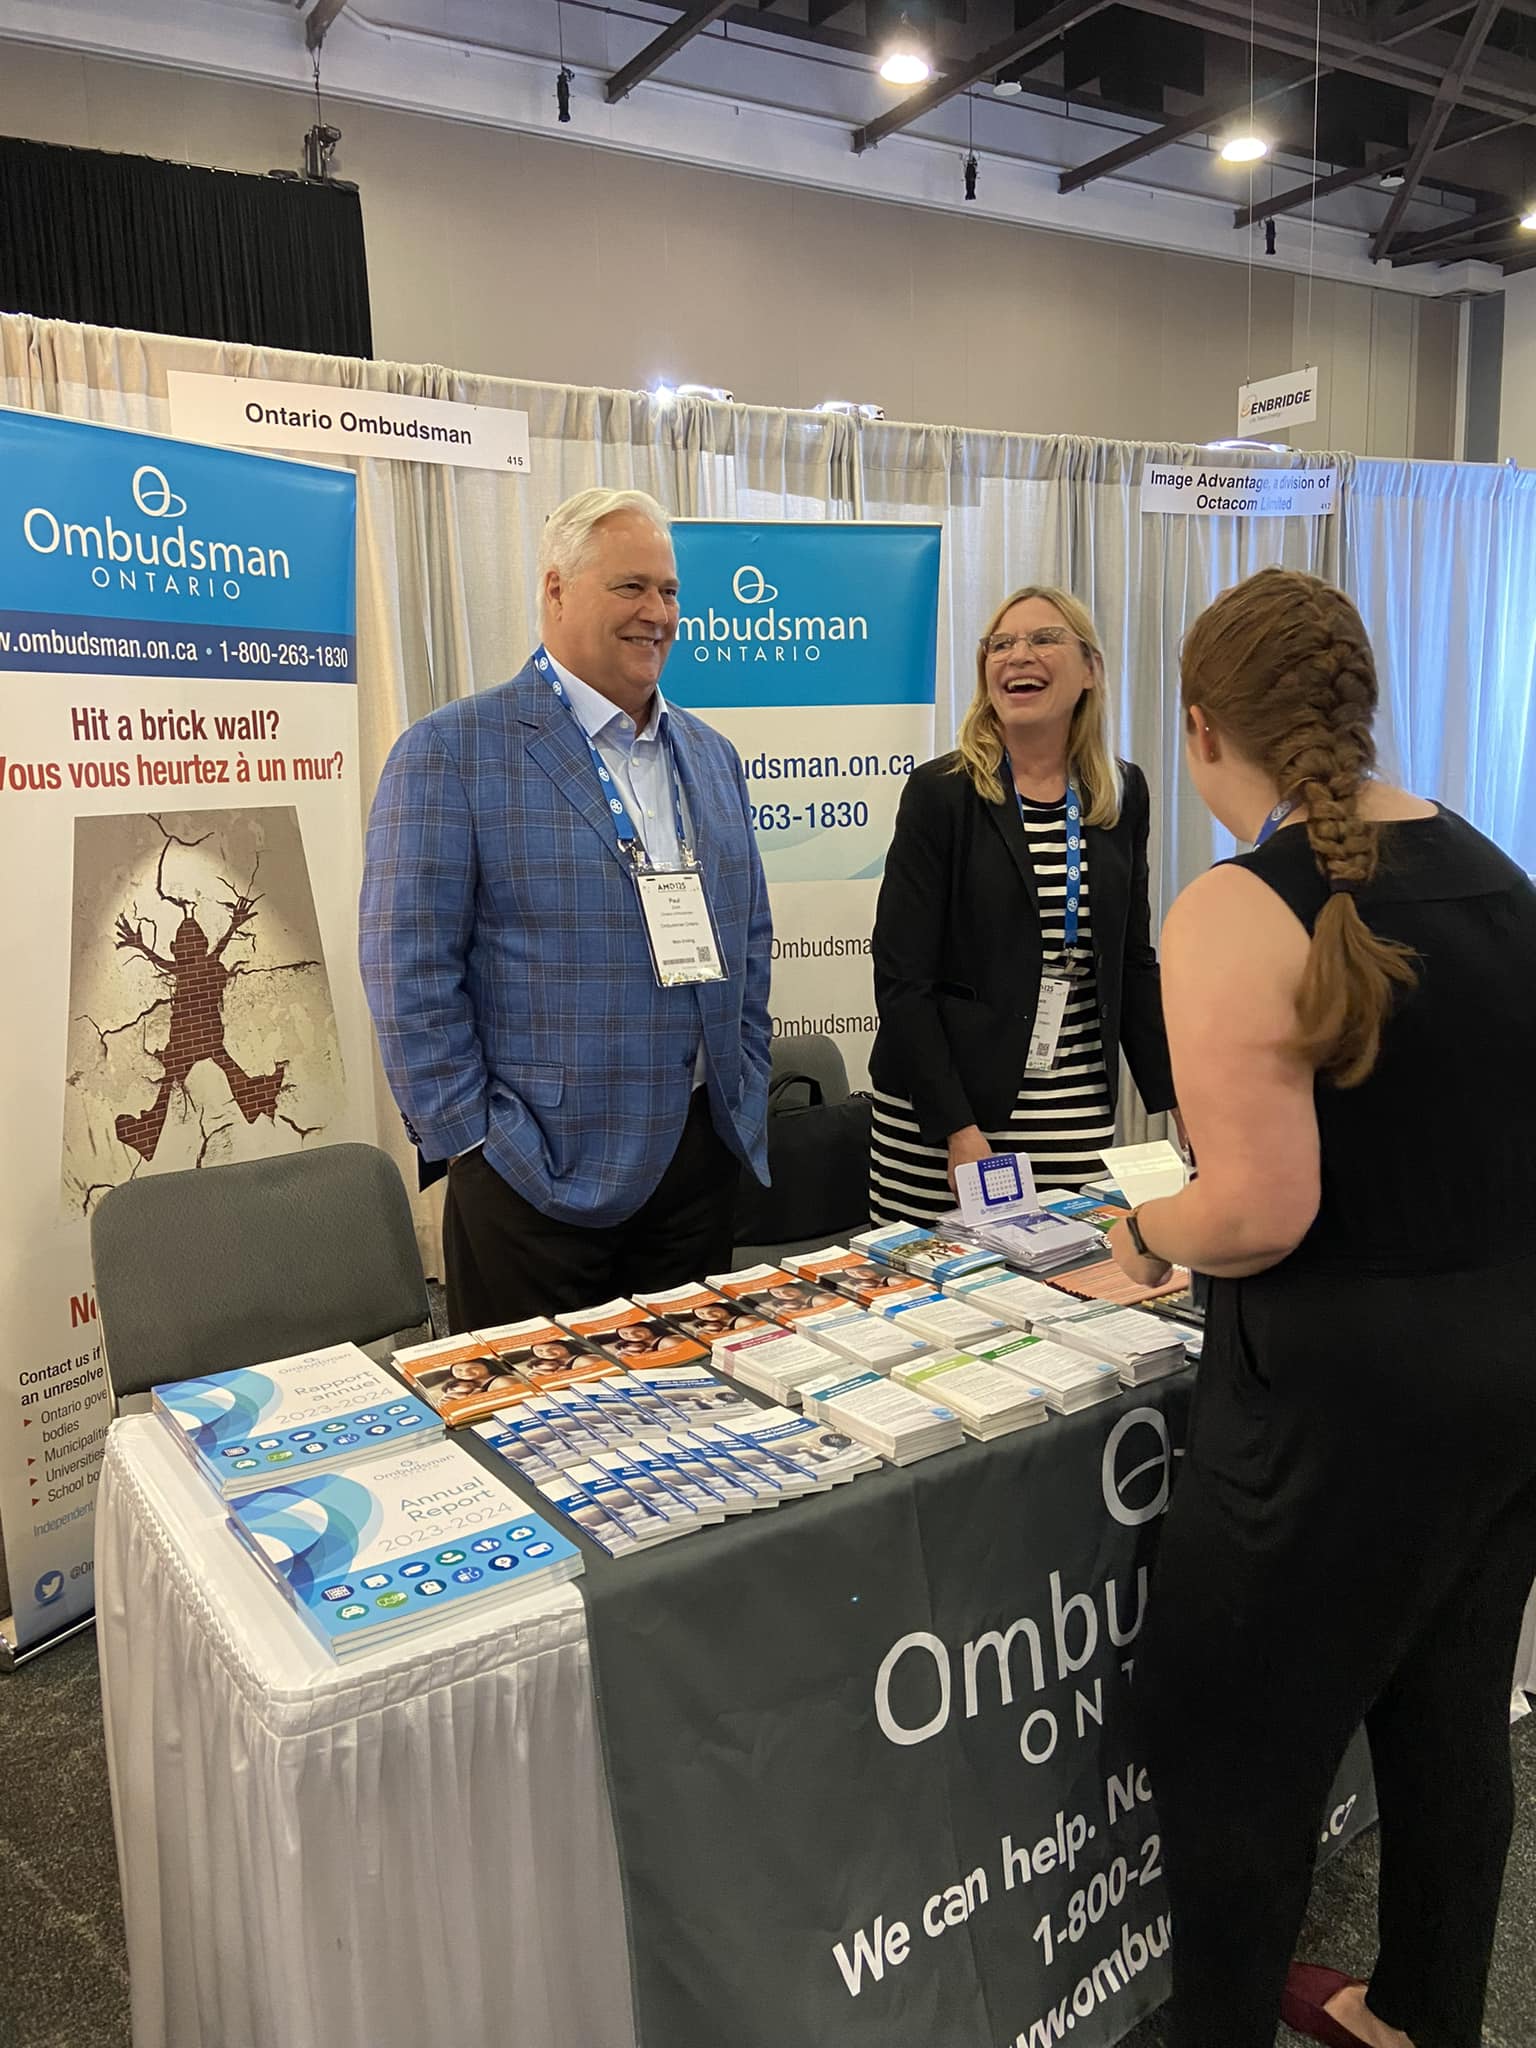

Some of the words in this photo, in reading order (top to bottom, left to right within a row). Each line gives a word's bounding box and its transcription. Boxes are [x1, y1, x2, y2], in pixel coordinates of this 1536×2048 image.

[1251, 389, 1312, 415] ENBRIDGE
[245, 402, 333, 431] Ontario
[339, 412, 473, 446] Ombudsman
[506, 455, 524, 467] 415
[1151, 471, 1193, 490] Image
[1280, 475, 1314, 489] division
[1318, 475, 1330, 489] of
[1197, 495, 1257, 511] Octacom
[23, 508, 290, 579] Ombudsman
[91, 567, 241, 600] ONTARIO
[219, 640, 349, 668] 1-800-263-1830
[694, 646, 820, 662] ONTARIO
[71, 707, 110, 741] Hit
[117, 716, 132, 740] a
[140, 709, 209, 741] brick
[215, 710, 280, 740] wall?
[68, 760, 131, 788] vous
[137, 754, 229, 785] heurtez
[237, 752, 250, 782] à
[258, 758, 287, 782] un
[293, 752, 344, 780] mur?
[19, 1358, 72, 1386] Contact
[75, 1353, 89, 1368] us
[93, 1346, 101, 1361] if
[294, 1371, 373, 1395] Rapport
[312, 1377, 381, 1401] annuel
[21, 1392, 39, 1407] an
[41, 1401, 82, 1424] Ontario
[276, 1388, 392, 1423] 2023-2024
[43, 1421, 79, 1442] bodies
[46, 1448, 105, 1482] Universities
[48, 1476, 84, 1502] School
[87, 1470, 101, 1484] bo
[401, 1476, 484, 1511] Annual
[408, 1490, 496, 1522] Report
[378, 1502, 512, 1552] 2023-2024
[874, 1567, 1148, 1746] Ombu
[832, 1915, 911, 1997] We
[922, 1866, 989, 1938] can
[1001, 1810, 1096, 1891] help.
[1032, 1834, 1163, 1966] 1-800-2
